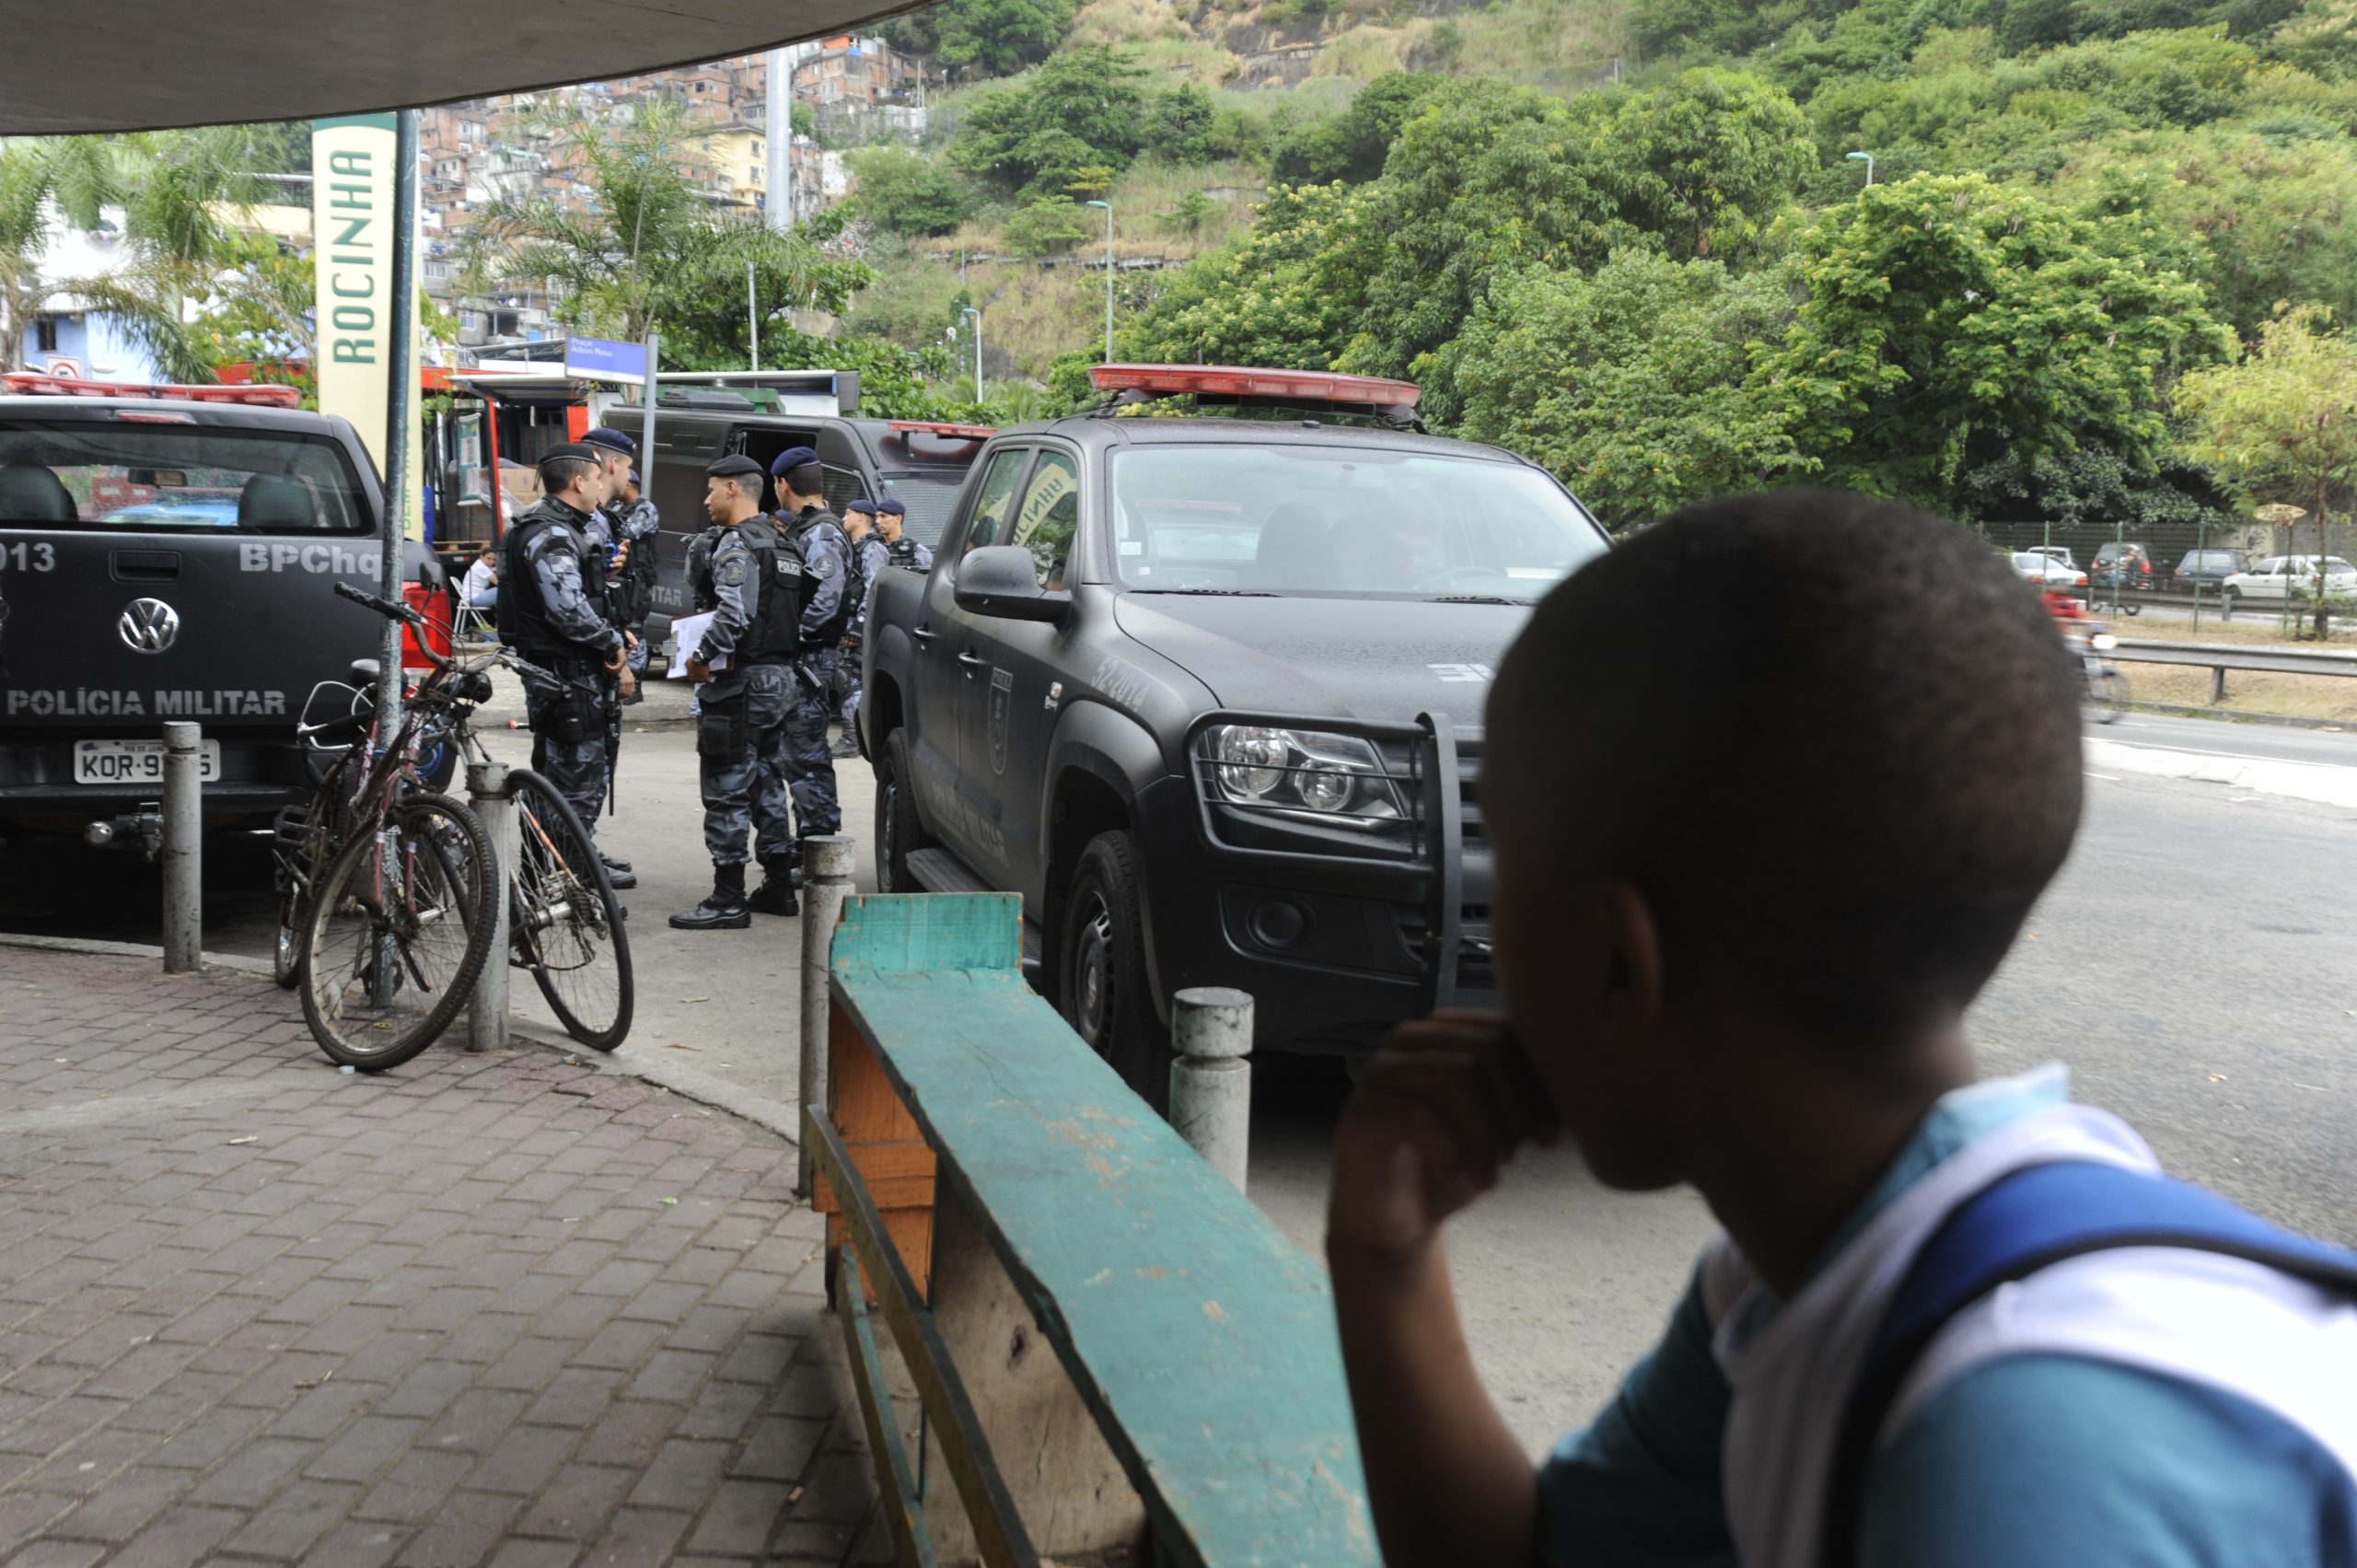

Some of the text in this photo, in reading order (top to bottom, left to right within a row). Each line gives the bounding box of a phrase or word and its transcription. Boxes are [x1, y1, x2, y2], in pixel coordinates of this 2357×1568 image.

[329, 149, 376, 365] ROCINHA
[239, 543, 383, 582] BPChq
[651, 585, 683, 608] ITAR
[6, 687, 286, 715] POLÍCIA MILITAR
